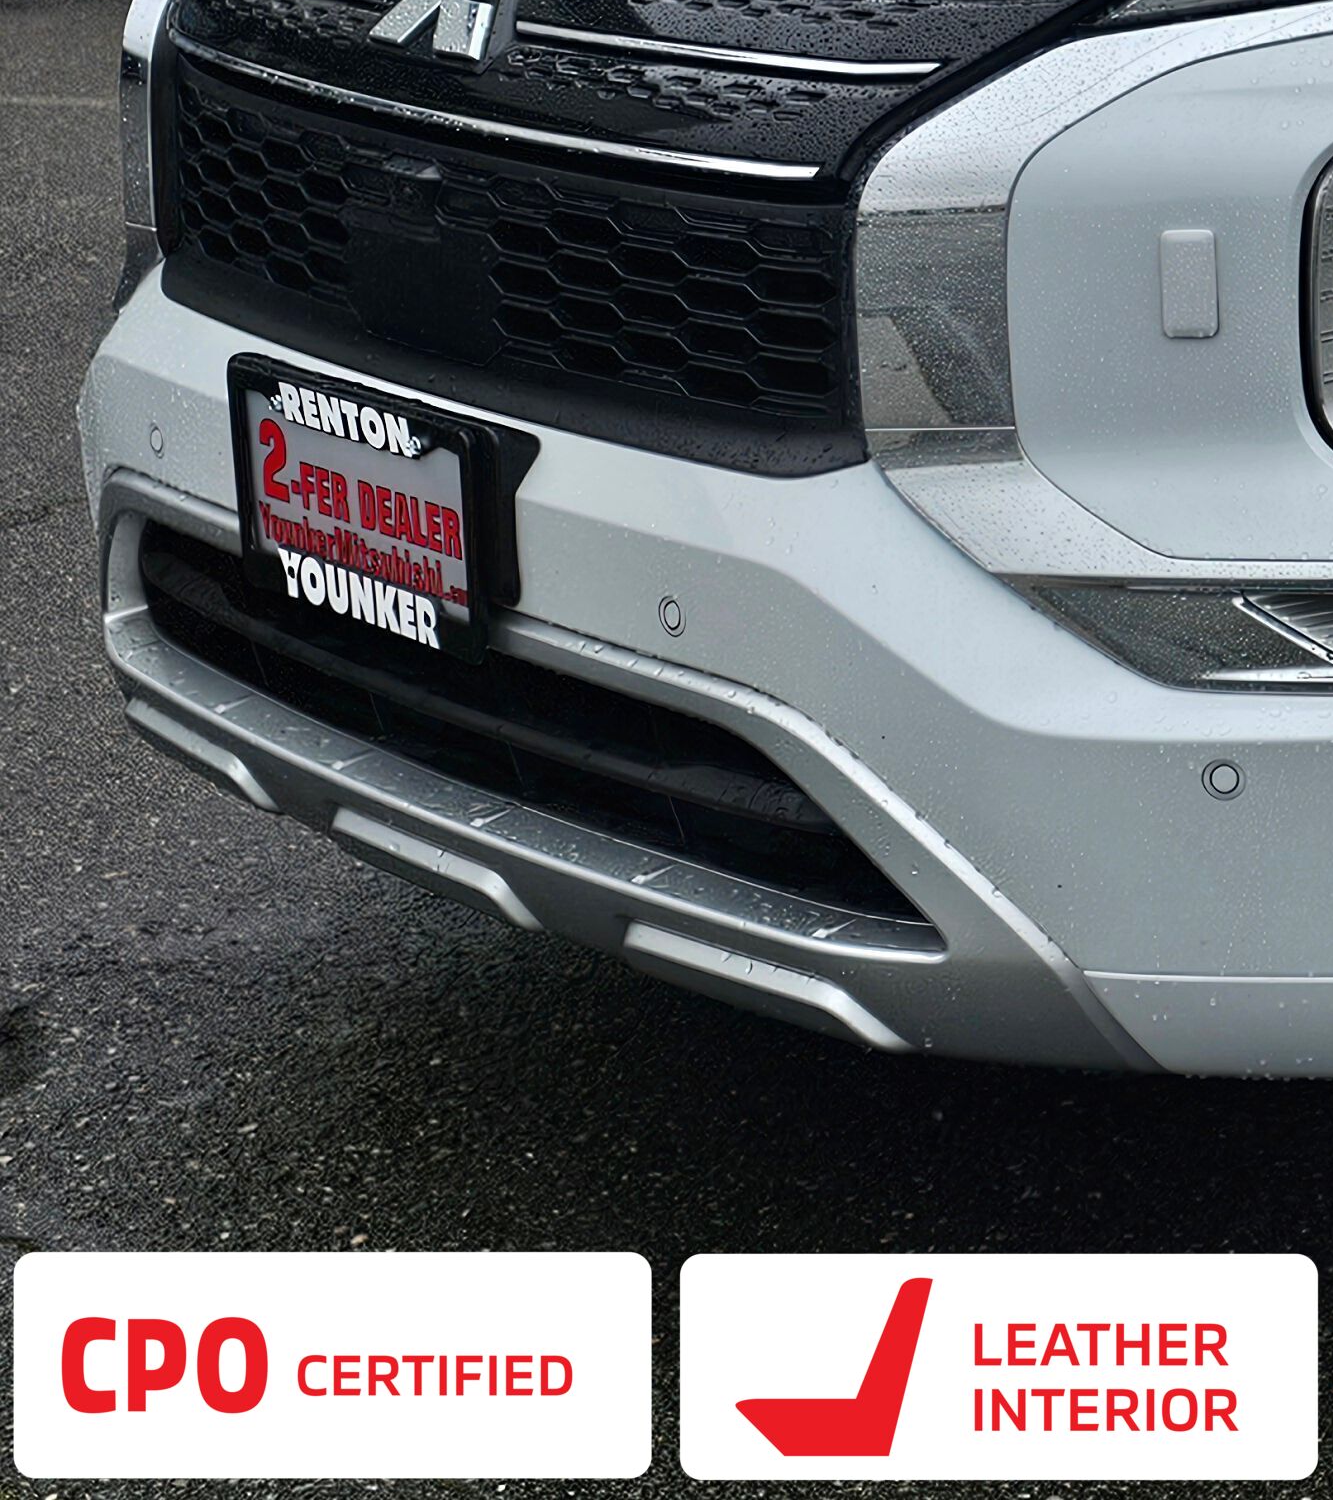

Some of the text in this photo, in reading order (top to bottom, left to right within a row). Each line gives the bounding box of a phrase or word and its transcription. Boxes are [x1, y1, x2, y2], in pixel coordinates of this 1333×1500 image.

[278, 381, 414, 459] RENTON
[258, 417, 464, 561] 2-FER DEALER
[277, 547, 441, 651] YOUNKER
